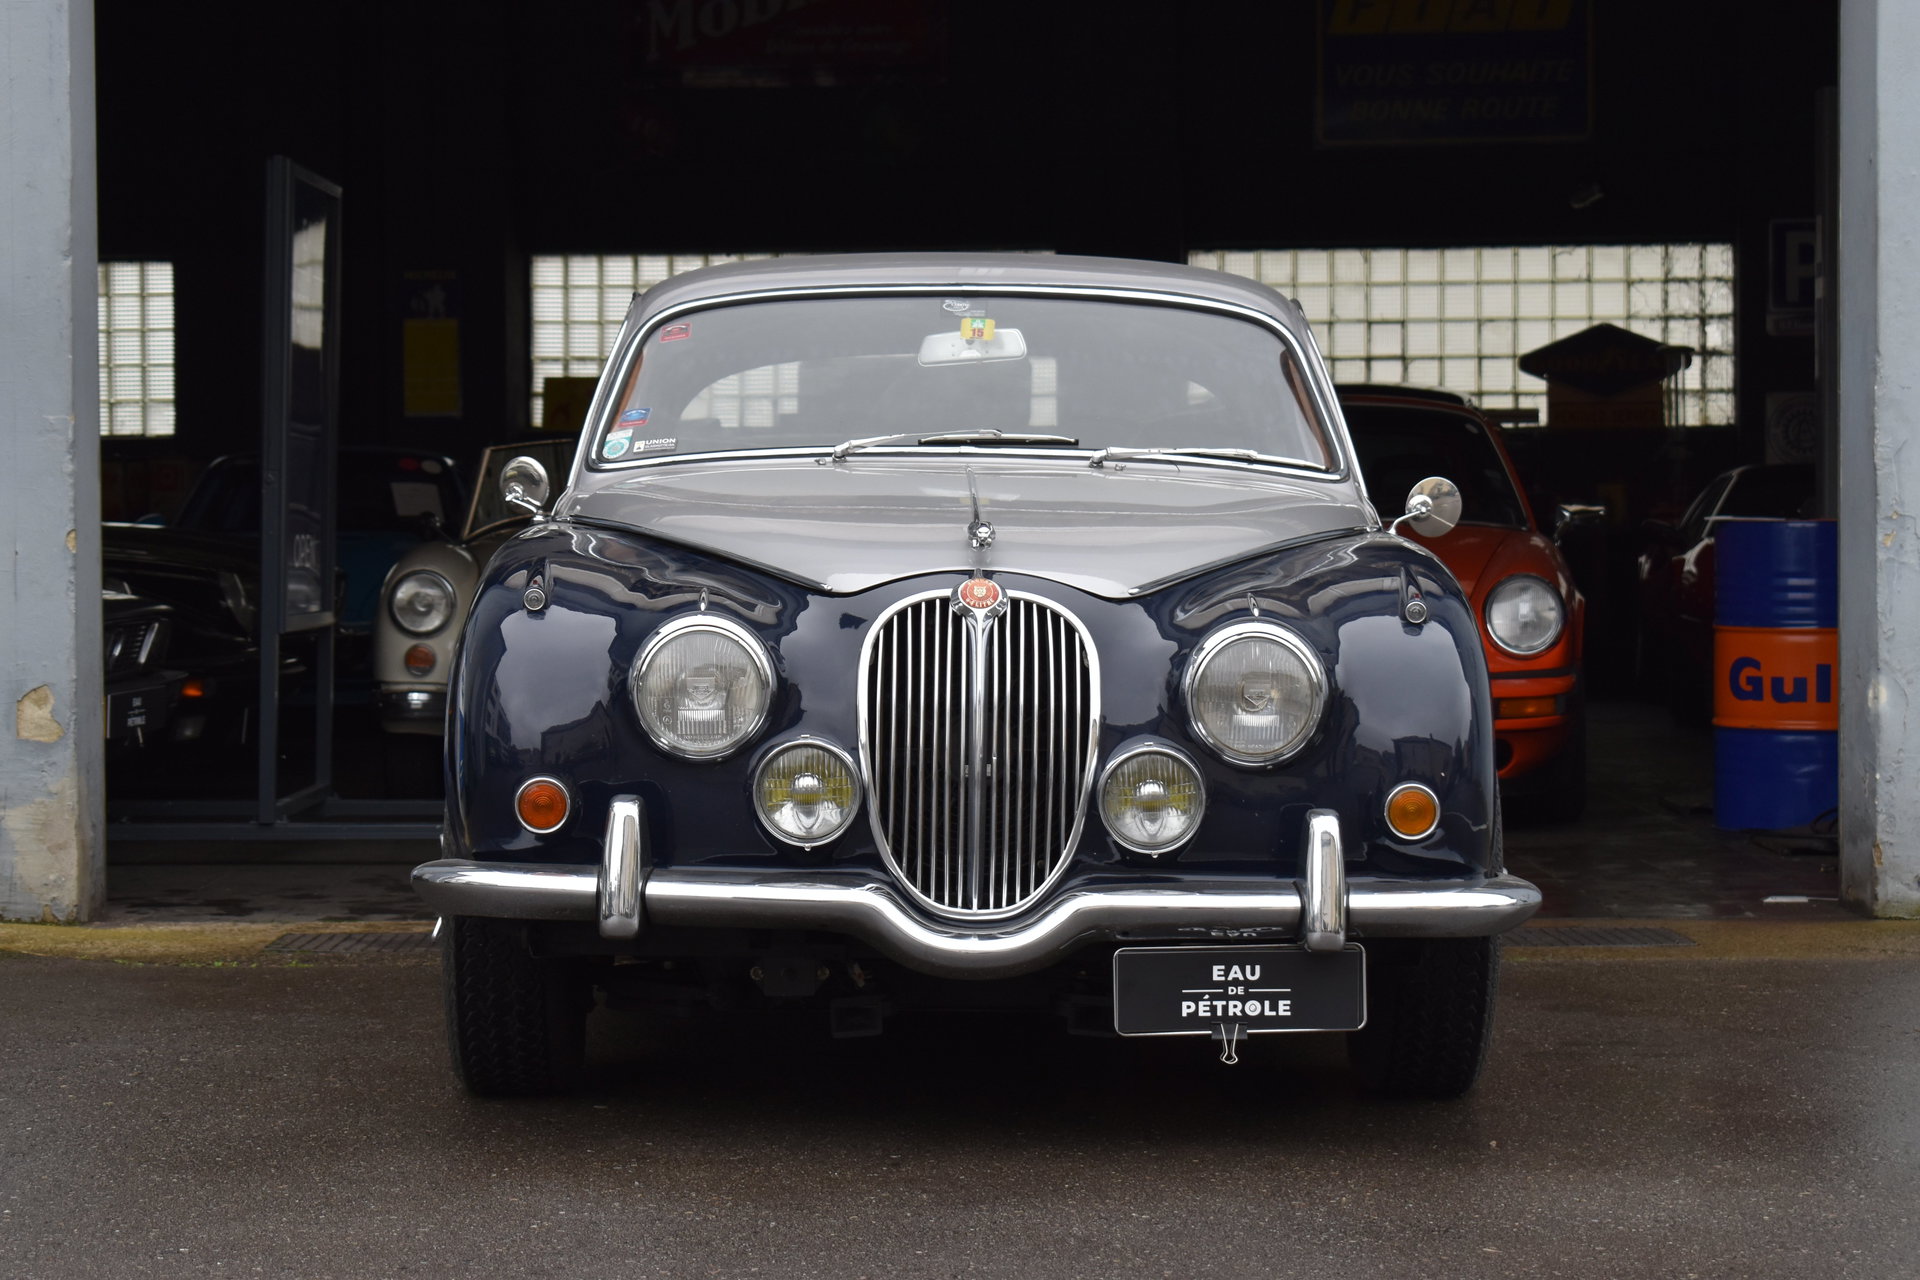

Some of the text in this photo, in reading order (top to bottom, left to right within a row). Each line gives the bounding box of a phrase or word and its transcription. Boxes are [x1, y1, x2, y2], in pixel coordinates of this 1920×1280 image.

[1336, 58, 1576, 87] VOUS SOUHAITE
[1350, 95, 1560, 122] BONNE ROUTE
[970, 328, 984, 338] 15
[1729, 656, 1831, 704] Gul
[1212, 964, 1261, 981] EAU
[1227, 985, 1245, 995] DE
[1181, 994, 1292, 1017] PÉTROLE
